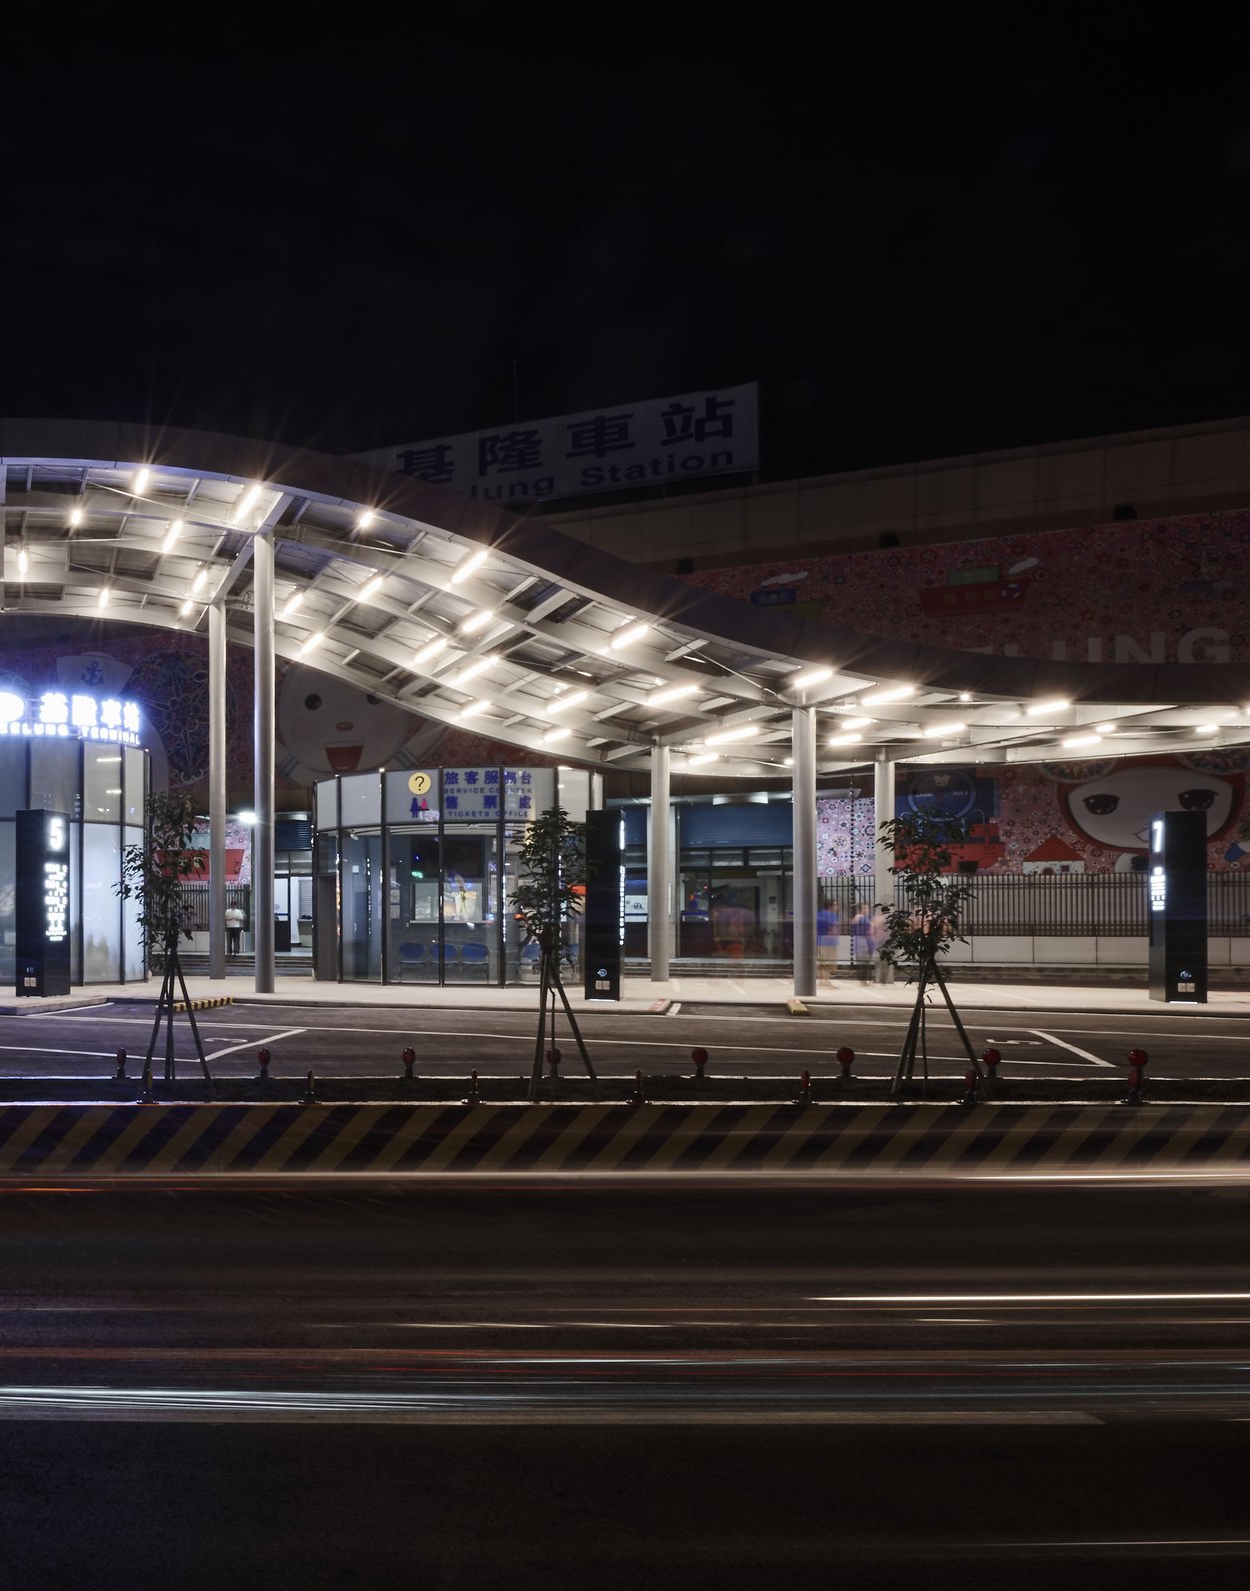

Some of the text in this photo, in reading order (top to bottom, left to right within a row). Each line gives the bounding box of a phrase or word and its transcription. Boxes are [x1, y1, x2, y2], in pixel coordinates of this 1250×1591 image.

[397, 396, 735, 484] 基隆車站
[581, 449, 734, 487] Station
[49, 819, 64, 850] 5
